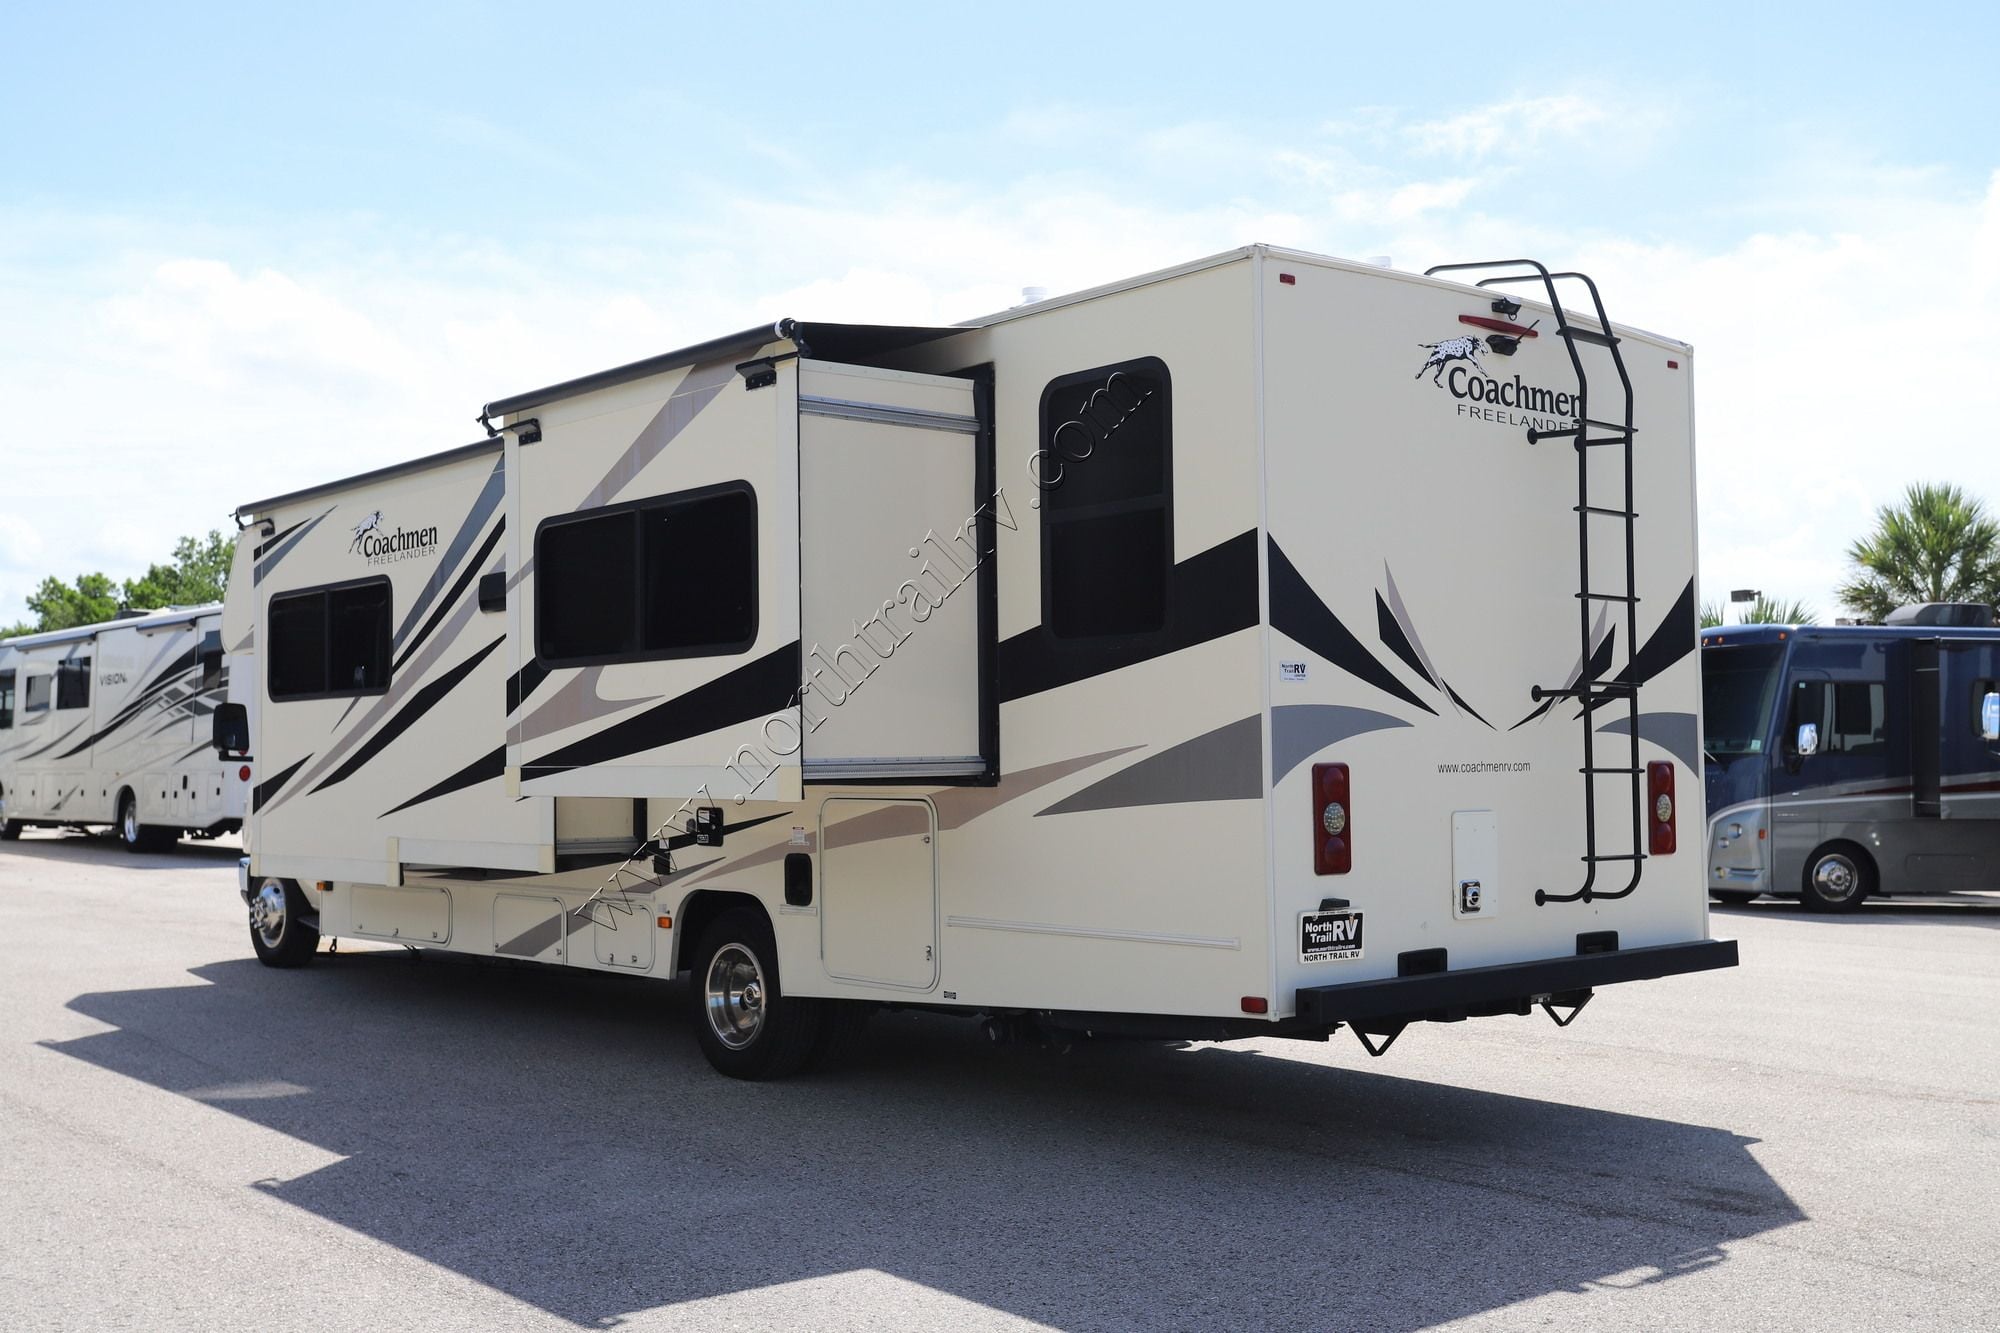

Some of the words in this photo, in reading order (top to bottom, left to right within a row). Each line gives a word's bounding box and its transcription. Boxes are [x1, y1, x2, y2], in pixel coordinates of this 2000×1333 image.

[363, 526, 438, 558] Coachmen
[367, 546, 436, 567] FREELANDER
[1437, 761, 1531, 773] www.coachmenrv.com
[1305, 922, 1332, 933] North
[1332, 920, 1358, 941] RV
[1310, 932, 1332, 943] Trail
[1303, 953, 1328, 962] NORTH
[1329, 951, 1349, 960] TRAIL
[1350, 950, 1360, 958] RV
